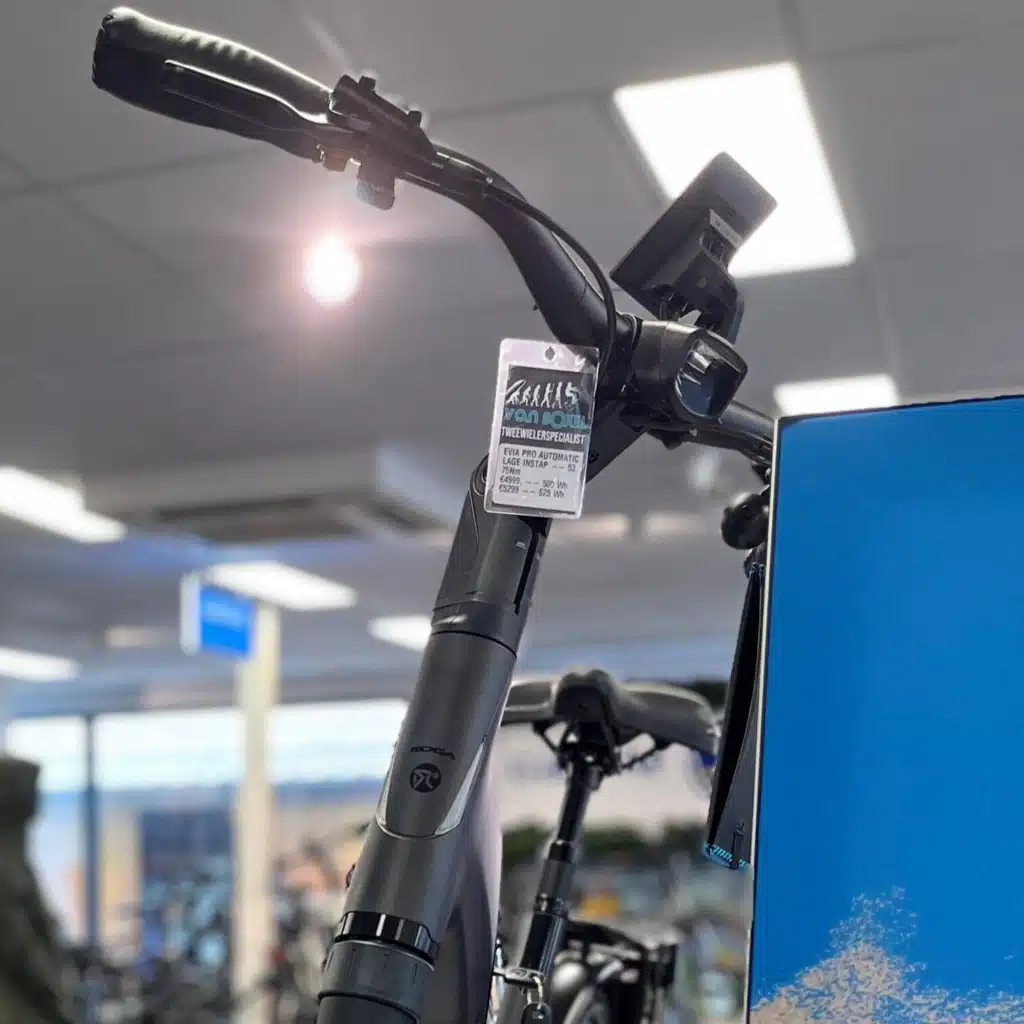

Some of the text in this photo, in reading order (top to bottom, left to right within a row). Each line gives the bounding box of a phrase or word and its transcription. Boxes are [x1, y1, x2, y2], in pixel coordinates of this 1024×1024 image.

[501, 426, 586, 445] TWEEWIELERSPECIALIST
[503, 447, 580, 463] EVIA PRO AUTOMATIC
[502, 457, 520, 467] LAGE
[523, 459, 549, 469] INSTAP
[501, 466, 521, 475] 75Nm
